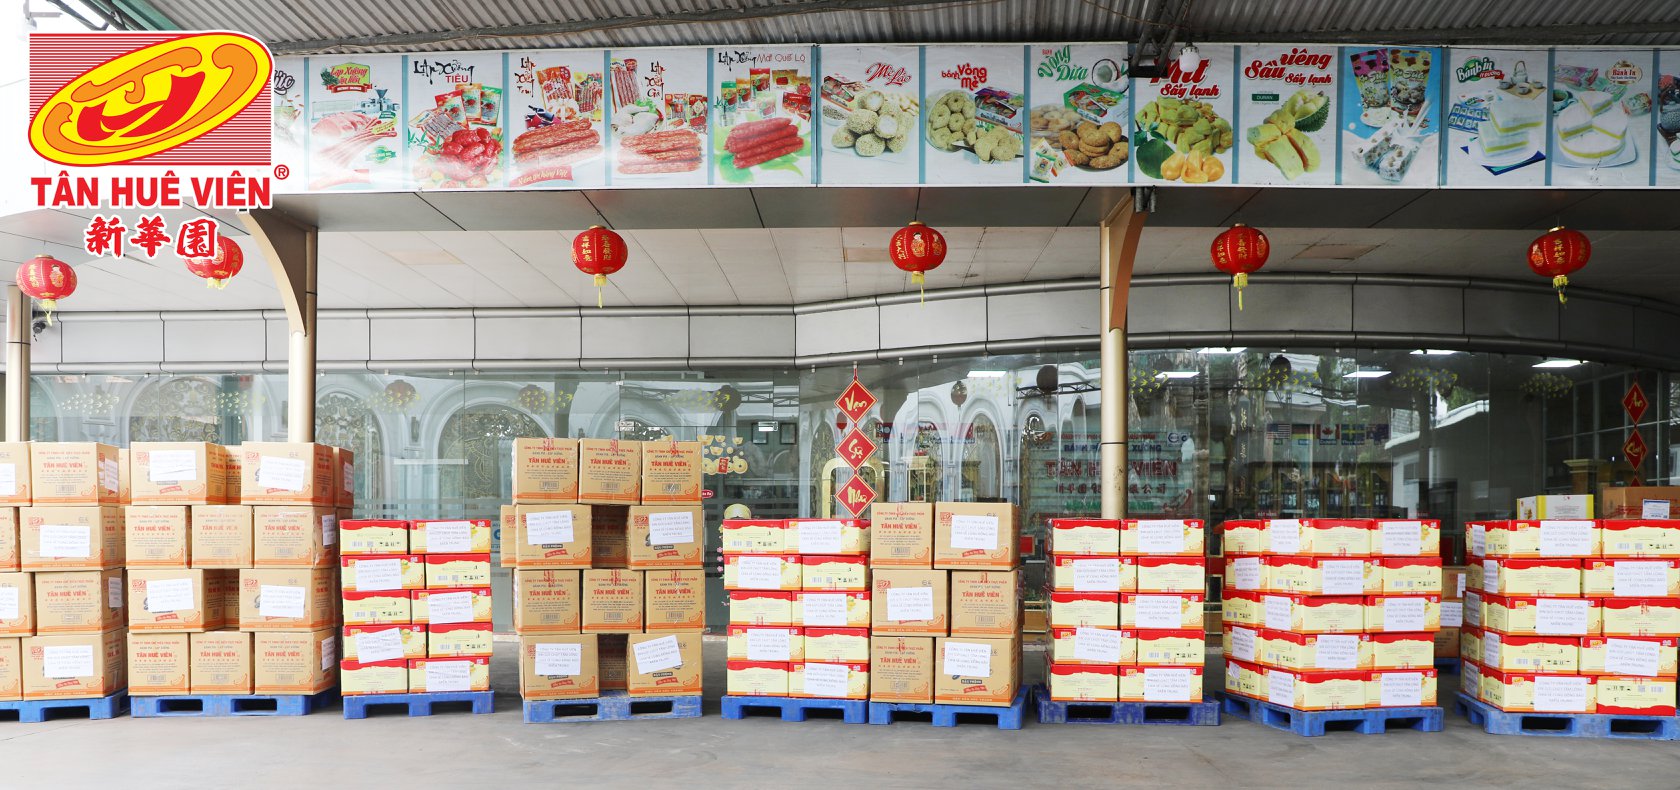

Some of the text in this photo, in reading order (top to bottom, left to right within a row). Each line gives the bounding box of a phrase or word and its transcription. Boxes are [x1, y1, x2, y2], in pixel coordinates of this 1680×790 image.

[1037, 45, 1071, 78] Vòng
[1244, 47, 1333, 79] Sầu riêng
[445, 73, 469, 83] TIÊU
[941, 63, 987, 83] bánh Vòng
[1056, 64, 1088, 81] Dừa
[1285, 72, 1332, 85] Sấy lạnh
[1160, 83, 1220, 99] Sấy lạnh
